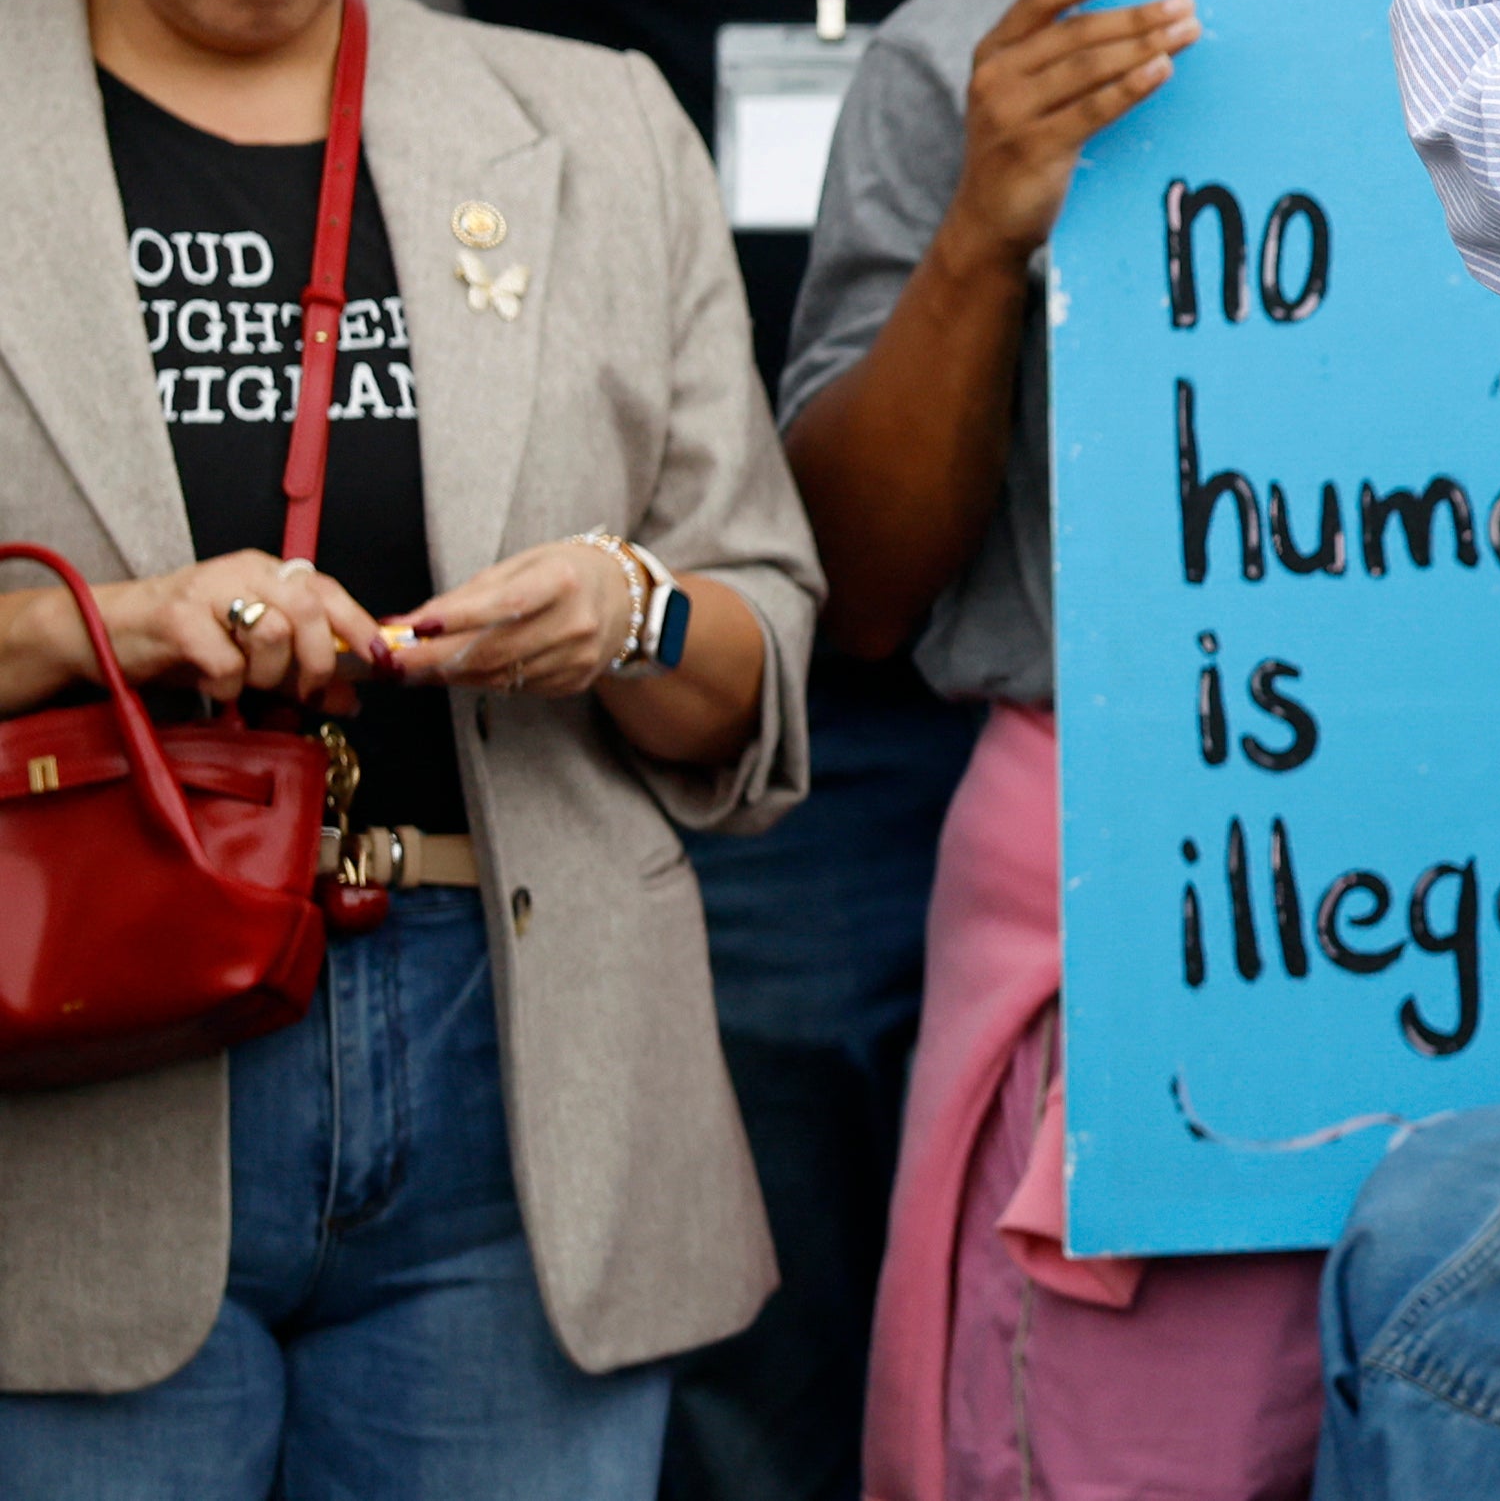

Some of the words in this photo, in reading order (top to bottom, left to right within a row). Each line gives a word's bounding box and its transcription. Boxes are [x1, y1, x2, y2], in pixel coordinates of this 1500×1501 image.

[130, 227, 274, 287] OUD
[1162, 179, 1332, 328] no
[1197, 631, 1320, 772] is
